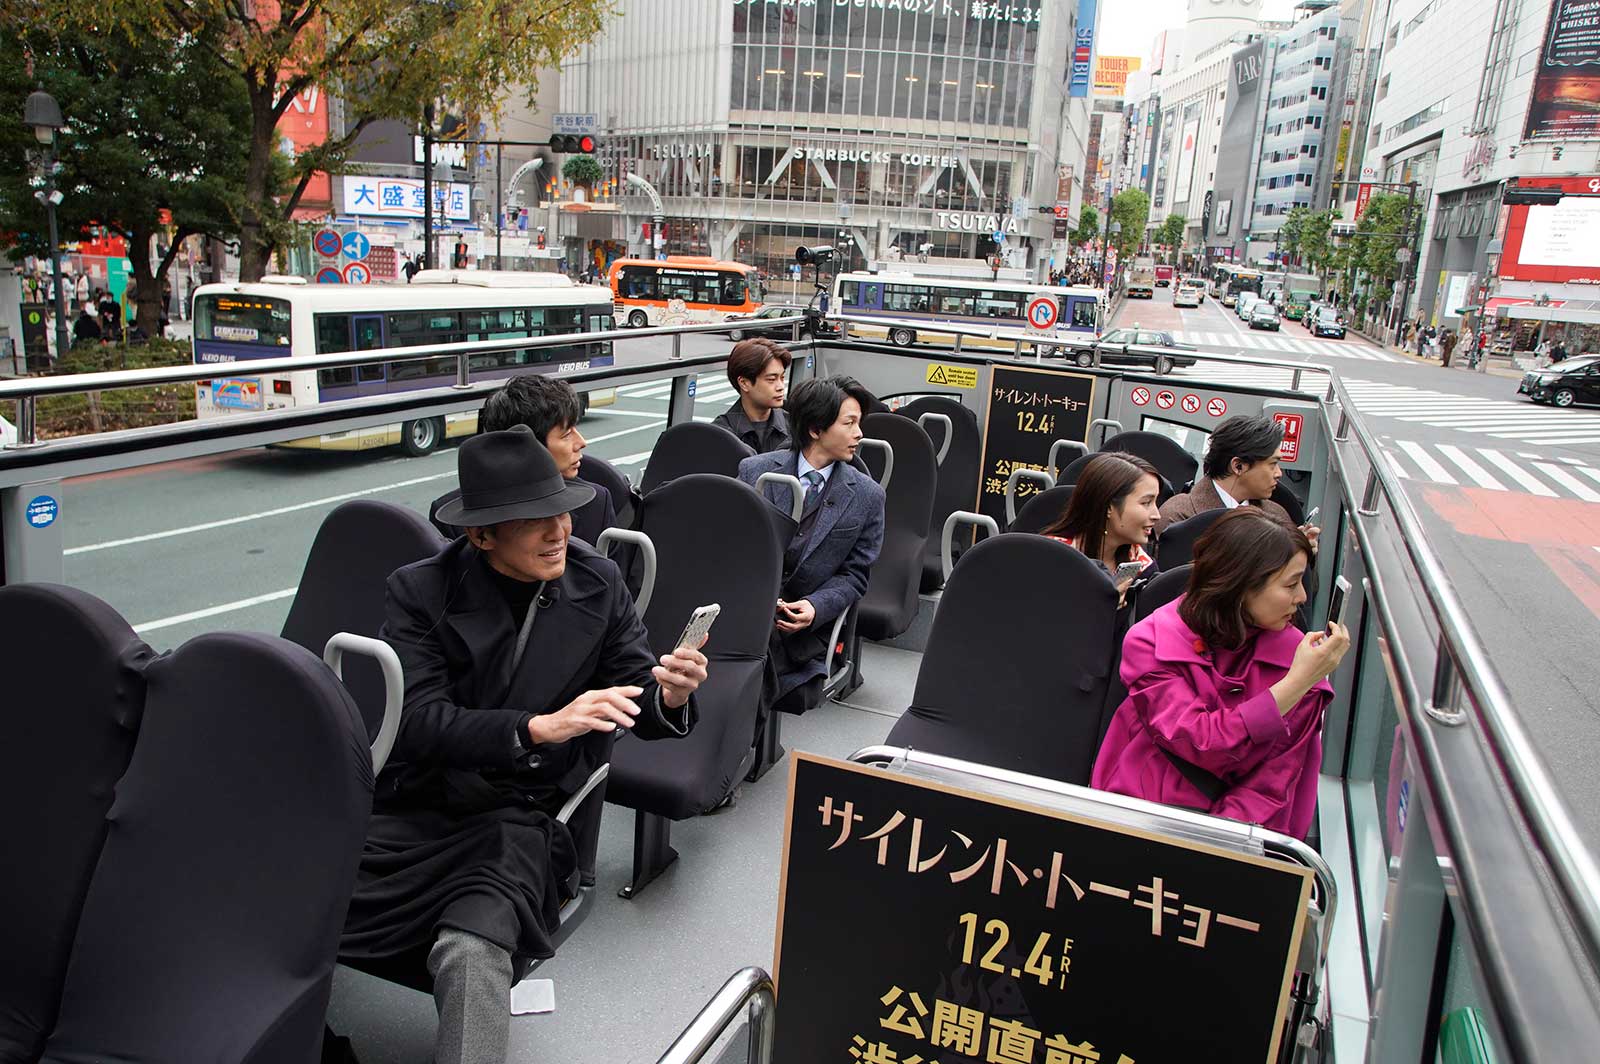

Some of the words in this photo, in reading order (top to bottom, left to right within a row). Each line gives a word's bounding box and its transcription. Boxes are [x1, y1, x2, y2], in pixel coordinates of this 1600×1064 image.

[1072, 28, 1091, 85] SEIBU
[1100, 58, 1128, 71] TOWER
[1095, 71, 1127, 83] RECORD
[654, 143, 712, 159] TSUTAYA
[793, 147, 890, 163] STARBUCKS
[900, 153, 958, 168] COFFEE
[937, 212, 1018, 233] TSUTAYA
[202, 353, 219, 361] KEIO
[559, 362, 575, 372] KEIO
[576, 361, 590, 370] BUS
[1016, 411, 1049, 434] 12.4
[1280, 441, 1296, 451] IRE
[817, 796, 1261, 948] サイレント・トーキョー
[958, 912, 1055, 987] 12.4
[1059, 937, 1075, 991] FRI
